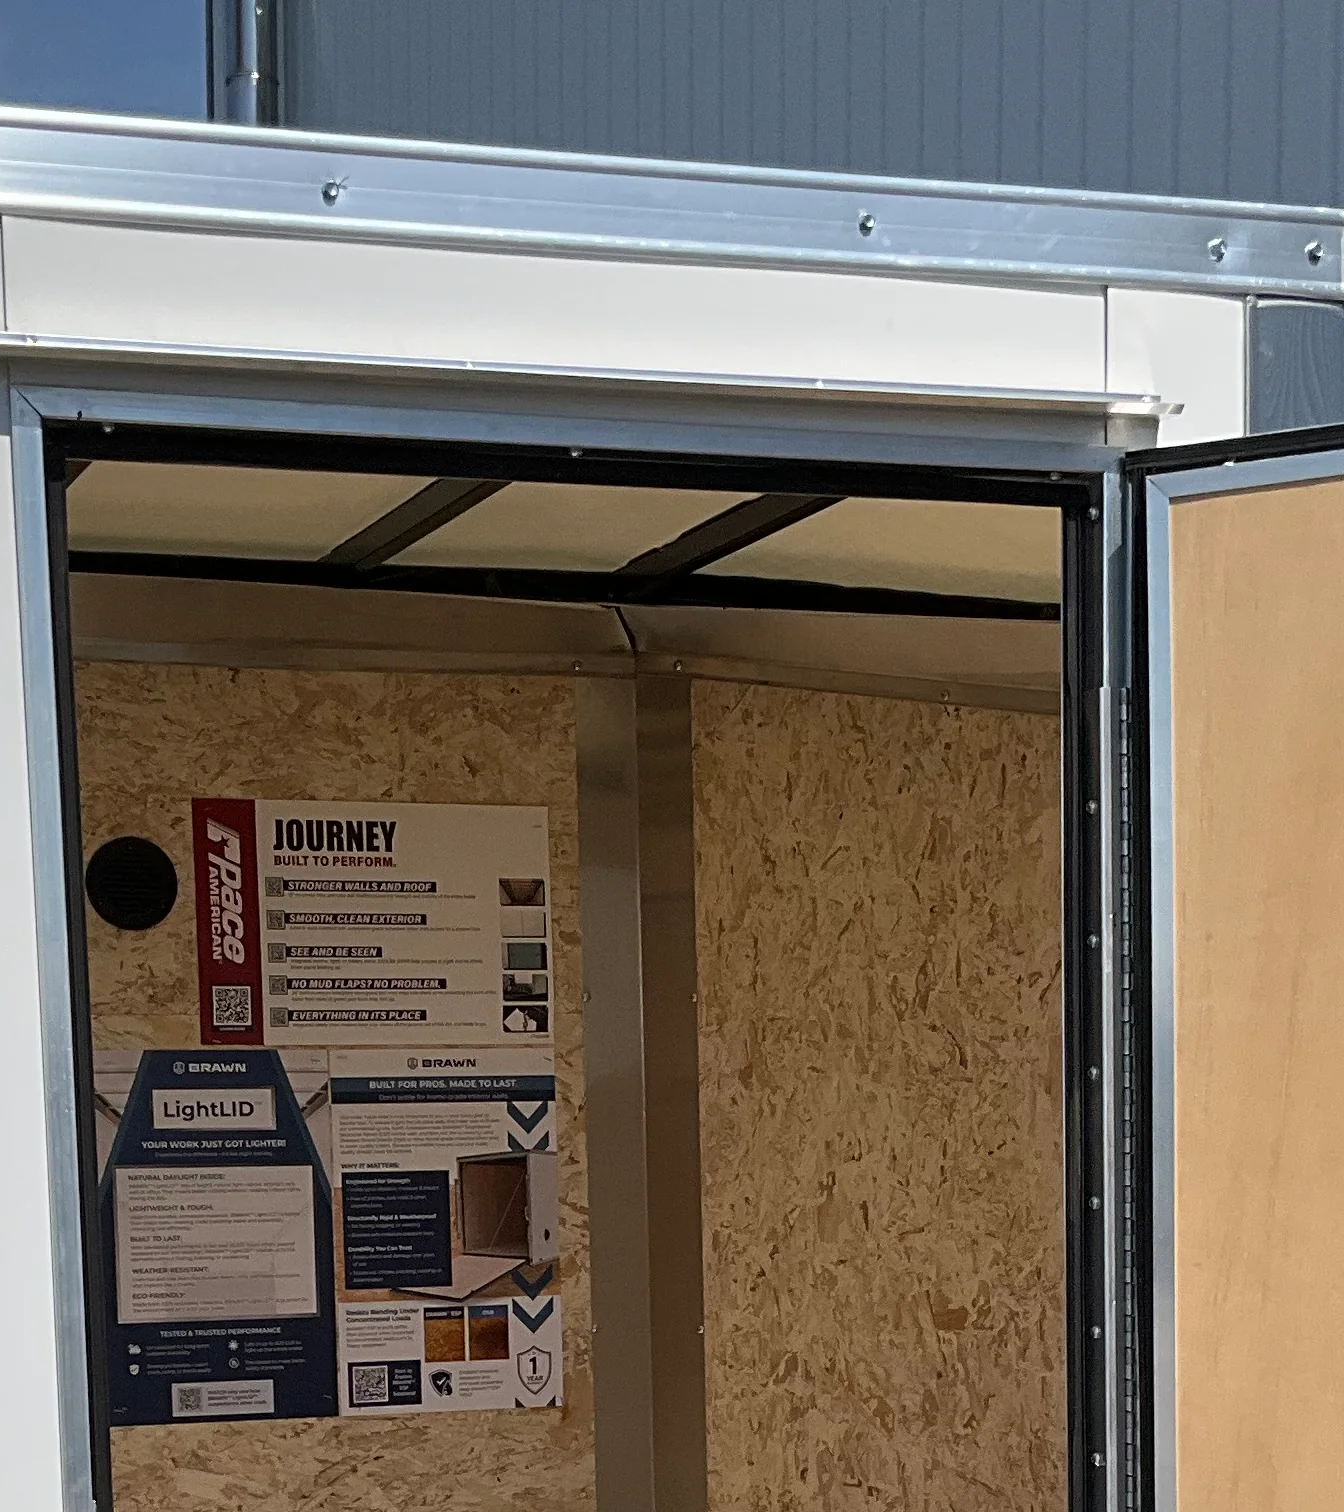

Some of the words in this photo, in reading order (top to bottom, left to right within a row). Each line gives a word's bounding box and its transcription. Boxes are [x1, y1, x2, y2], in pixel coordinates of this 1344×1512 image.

[273, 818, 397, 852] JOURNEY
[273, 855, 310, 868] BUILT
[312, 855, 329, 868] TO
[332, 855, 397, 868] PERFORM.
[287, 881, 343, 892] STRONGER
[344, 881, 379, 892] WALLS
[380, 881, 402, 892] AND
[403, 881, 433, 892] ROOF
[207, 852, 246, 965] Pace
[208, 866, 223, 961] AMERICAN
[289, 914, 336, 925] SMOOTH,
[337, 914, 370, 924] CLEAN
[371, 914, 422, 924] EXTERIOR
[290, 947, 309, 957] SEE
[311, 947, 334, 957] AND
[335, 947, 350, 957] BE
[351, 947, 378, 957] SEEN
[291, 979, 307, 989] NO
[309, 979, 332, 989] MUD
[334, 979, 373, 989] FLAPS?
[374, 979, 389, 989] NO
[390, 979, 441, 990] PROBLEM.
[292, 1011, 357, 1021] EVERYTHING
[358, 1011, 369, 1021] IN
[370, 1011, 387, 1021] ITS
[388, 1011, 422, 1021] PLACE
[188, 1062, 247, 1073] BRAWN
[422, 1058, 477, 1068] BRAWN
[369, 1080, 395, 1089] BUILT
[398, 1080, 417, 1089] FOR
[419, 1080, 447, 1089] PROS.
[449, 1079, 477, 1088] MADE
[479, 1079, 493, 1088] TO
[163, 1100, 255, 1121] LightLID
[141, 1140, 168, 1149] YOUR
[169, 1140, 199, 1149] WORK
[200, 1139, 223, 1149] JUST
[224, 1139, 244, 1148] GOT
[245, 1139, 287, 1148] LIGHTER!
[528, 1356, 538, 1375] 1
